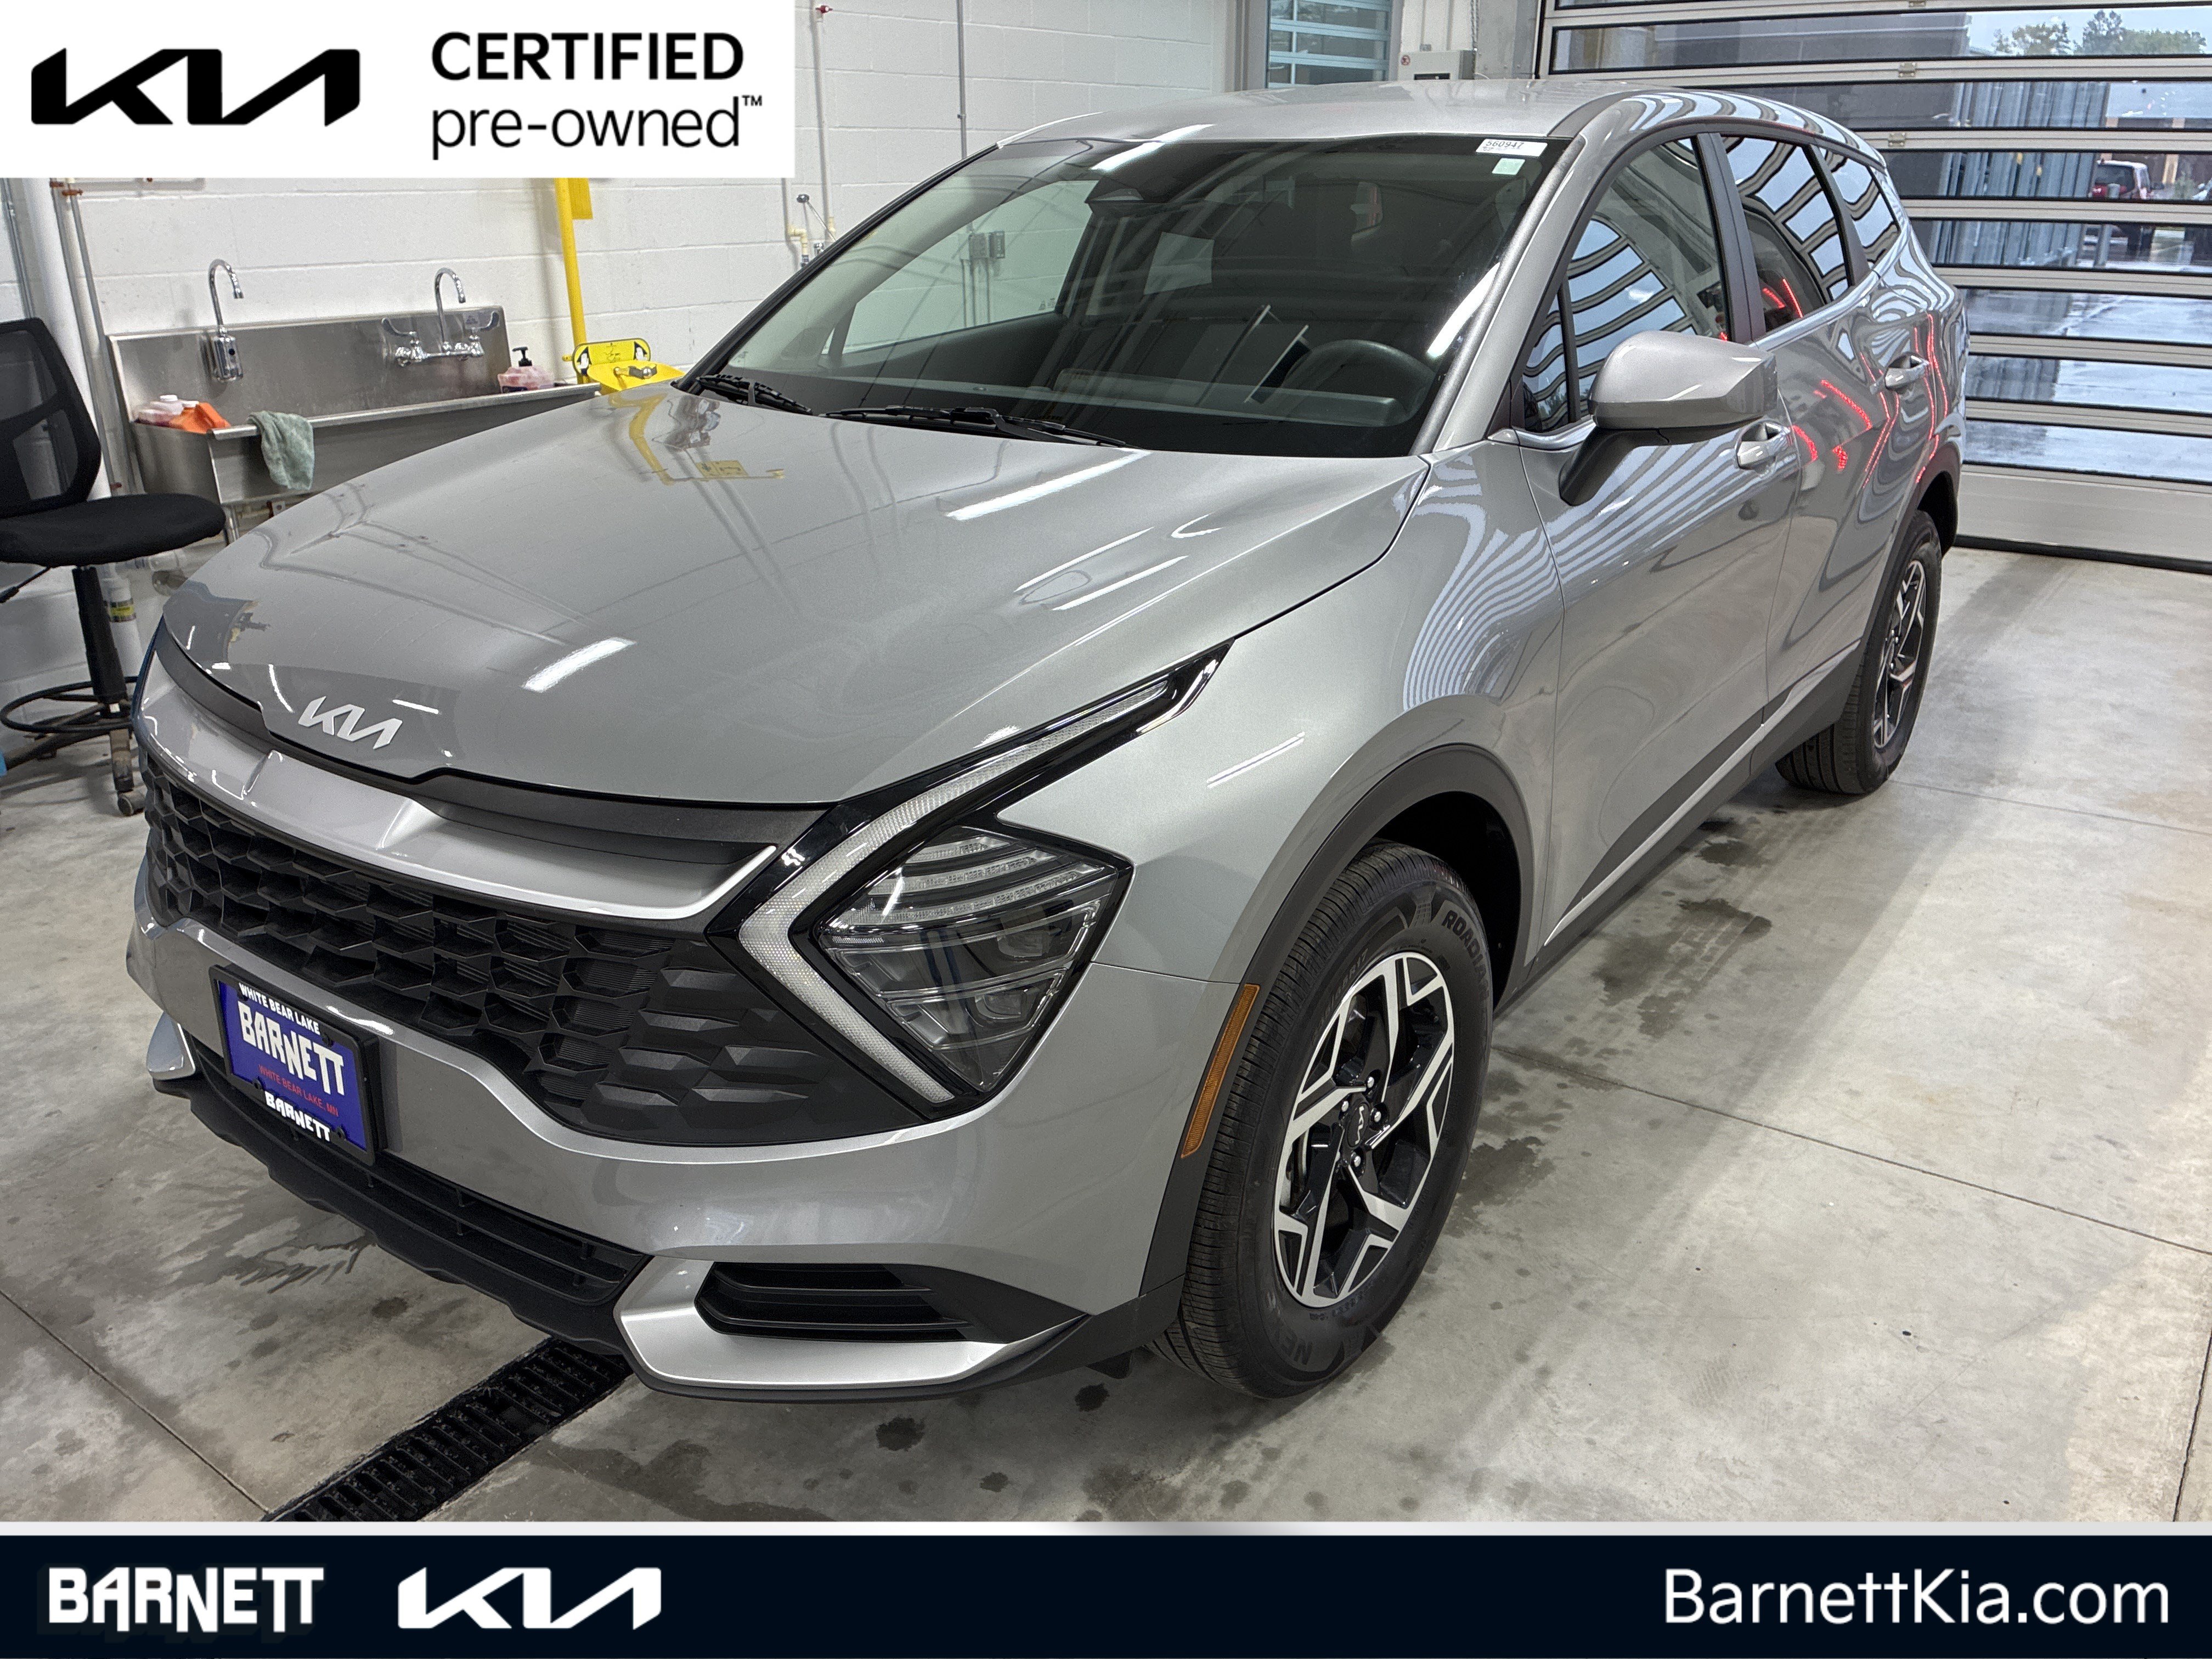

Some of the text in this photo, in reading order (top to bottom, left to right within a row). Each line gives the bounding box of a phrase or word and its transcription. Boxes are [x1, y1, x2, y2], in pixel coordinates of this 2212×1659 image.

[298, 696, 402, 749] KIA
[239, 983, 320, 1035] WHITE BEAR LAKE
[238, 1001, 345, 1096] BARNETT
[258, 1064, 283, 1084] WHITE
[283, 1077, 302, 1097] BEAR
[326, 1102, 338, 1118] MN
[264, 1091, 331, 1142] BARNETT
